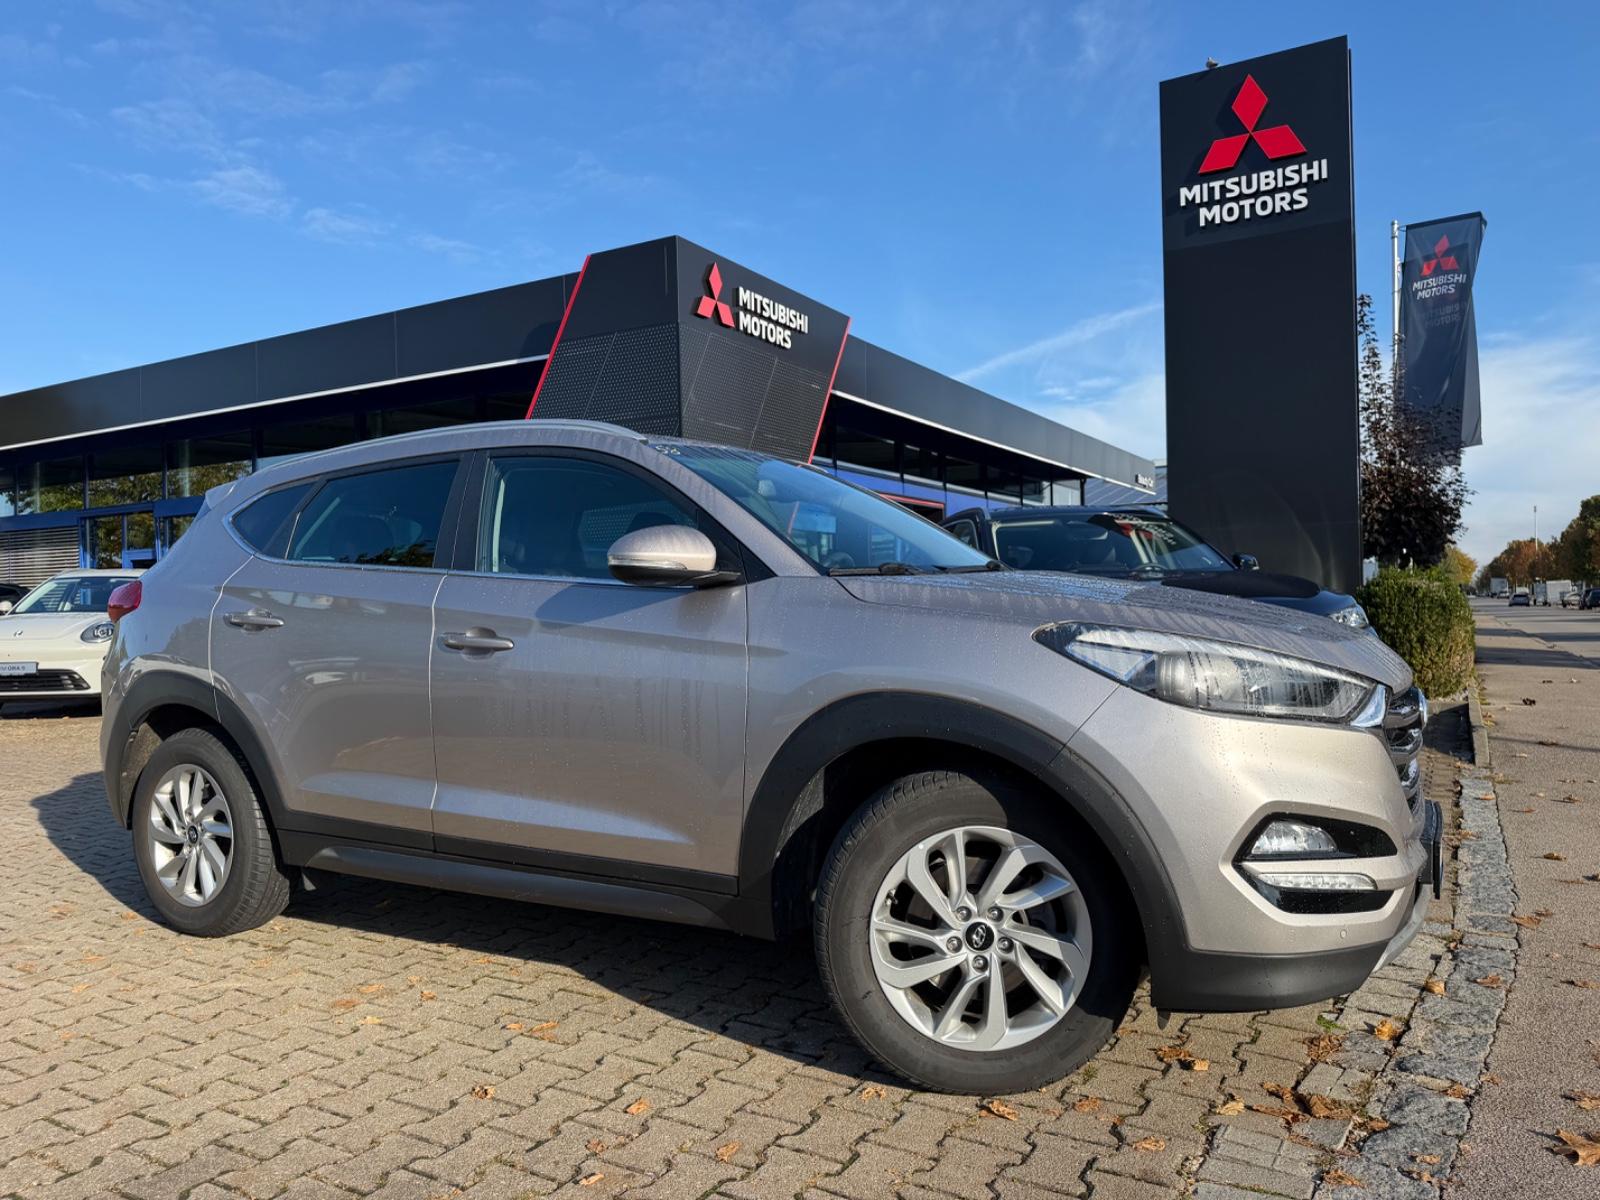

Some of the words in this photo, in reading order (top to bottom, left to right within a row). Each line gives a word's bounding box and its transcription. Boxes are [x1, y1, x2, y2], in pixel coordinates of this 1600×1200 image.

[1179, 158, 1328, 207] MITSUBISHI
[1199, 188, 1309, 227] MOTORS
[1412, 273, 1467, 292] MITSUBISHI
[1416, 284, 1456, 300] MOTORS
[738, 285, 809, 335] MITSUBISHI
[738, 310, 792, 350] MOTORS
